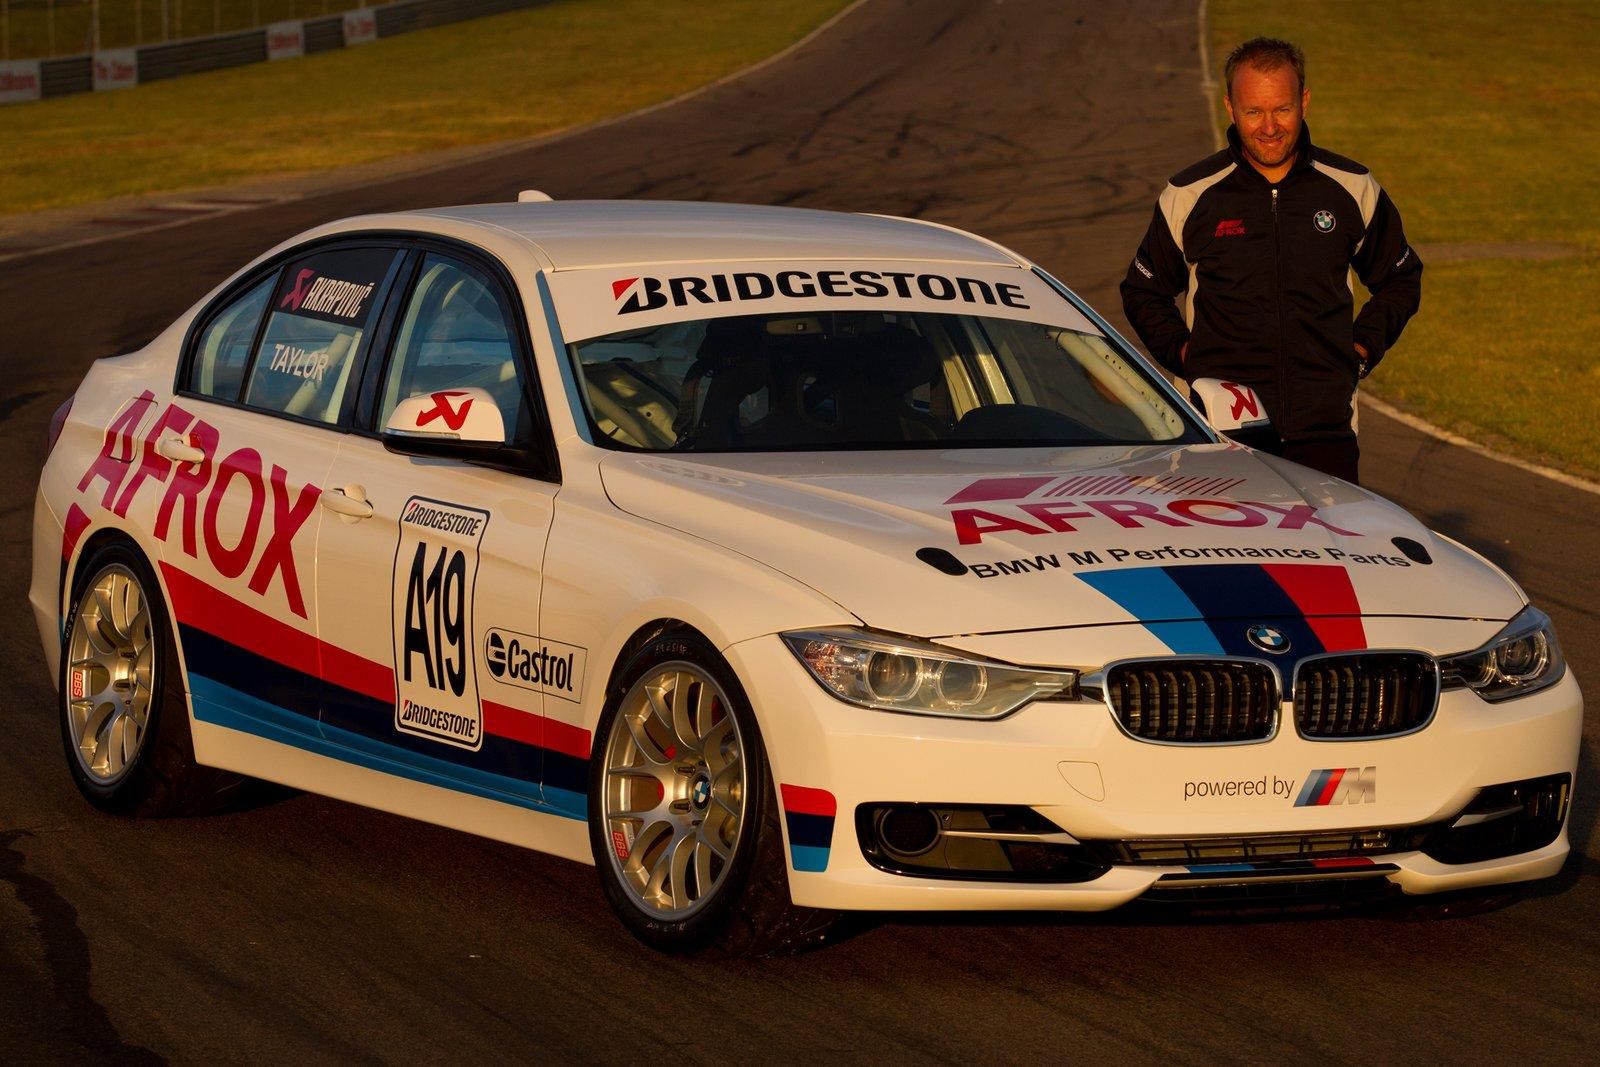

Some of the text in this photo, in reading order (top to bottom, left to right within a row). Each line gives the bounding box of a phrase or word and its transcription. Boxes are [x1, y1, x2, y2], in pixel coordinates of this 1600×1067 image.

[612, 270, 1031, 315] BRIDGESTONE
[269, 343, 330, 382] TAYLOR
[77, 389, 322, 620] AFROX
[403, 501, 483, 537] BRIDGESTONE
[950, 498, 1365, 545] AFROX
[968, 545, 1411, 579] BMW M Performance Parts
[403, 541, 466, 698] A19
[73, 672, 83, 697] BBS
[506, 638, 574, 693] Castrol
[401, 699, 477, 739] BRIDGESTONE
[1184, 775, 1267, 802] powered
[1273, 775, 1295, 799] by
[613, 832, 628, 859] BBS
